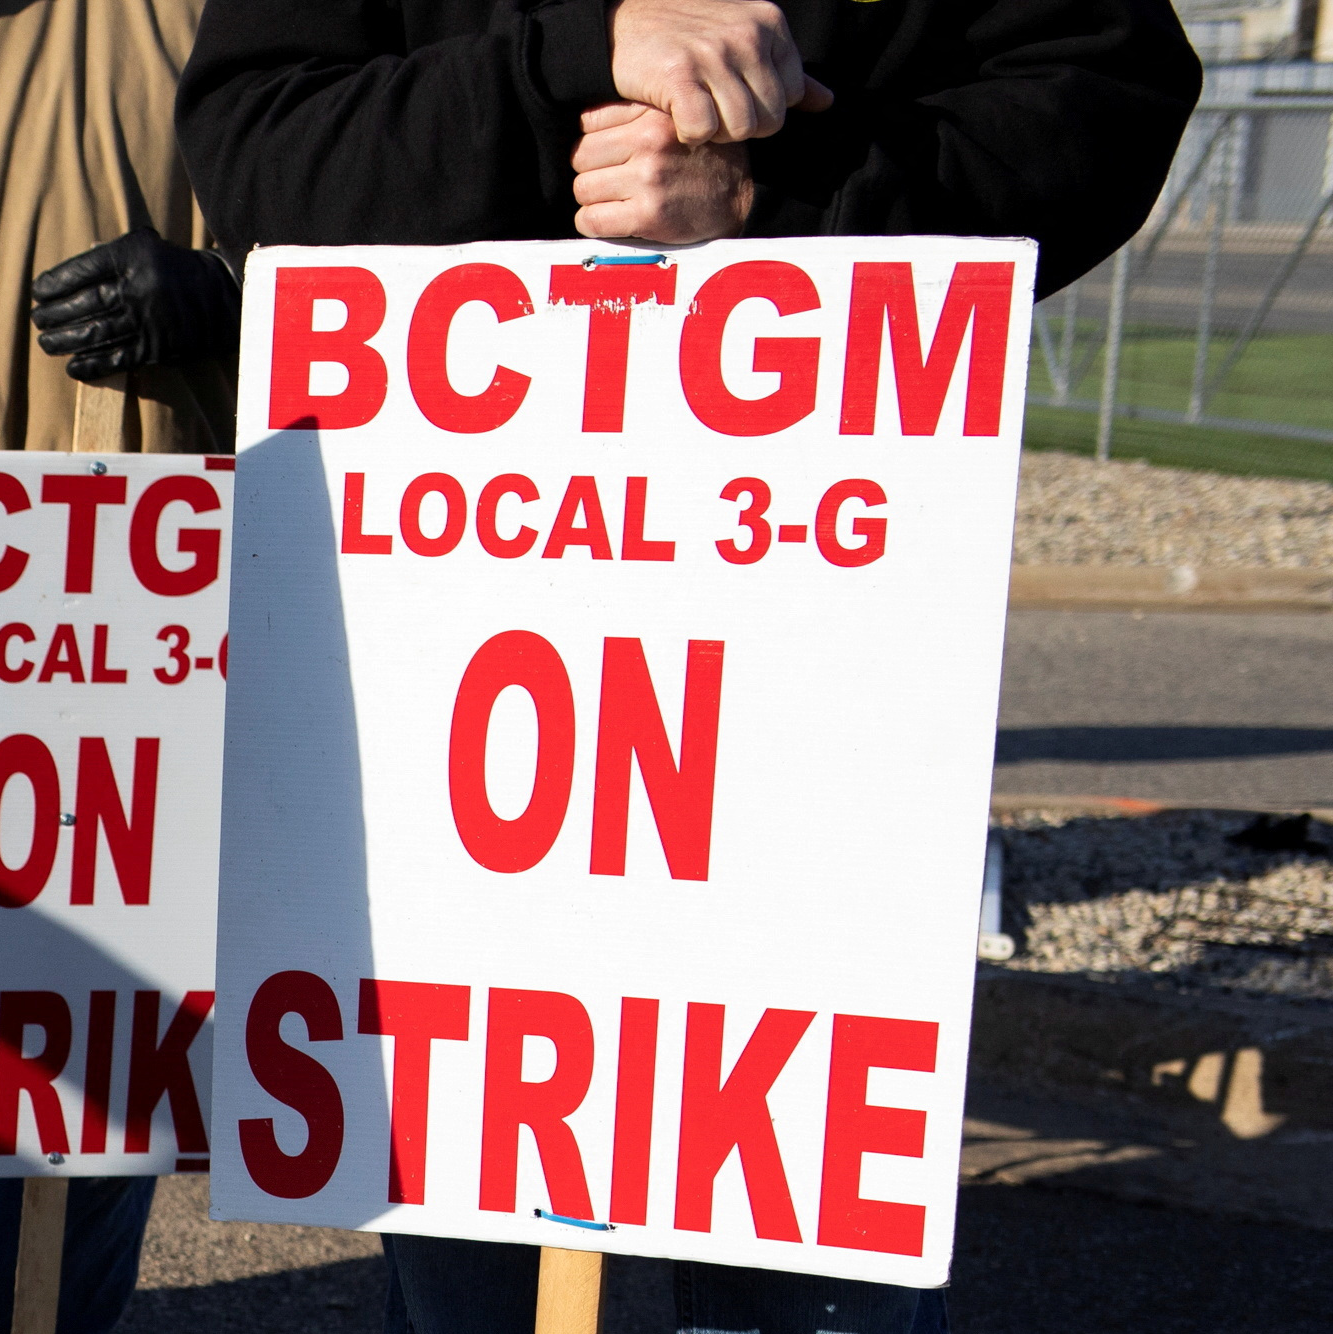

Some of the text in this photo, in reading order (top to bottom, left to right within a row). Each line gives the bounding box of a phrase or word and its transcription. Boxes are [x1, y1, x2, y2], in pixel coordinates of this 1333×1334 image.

[267, 259, 1015, 438] BCTGM
[340, 471, 889, 568] LOCAL 3-G
[153, 624, 228, 685] 3-
[447, 629, 726, 882] ON
[237, 969, 941, 1258] STRIKE
